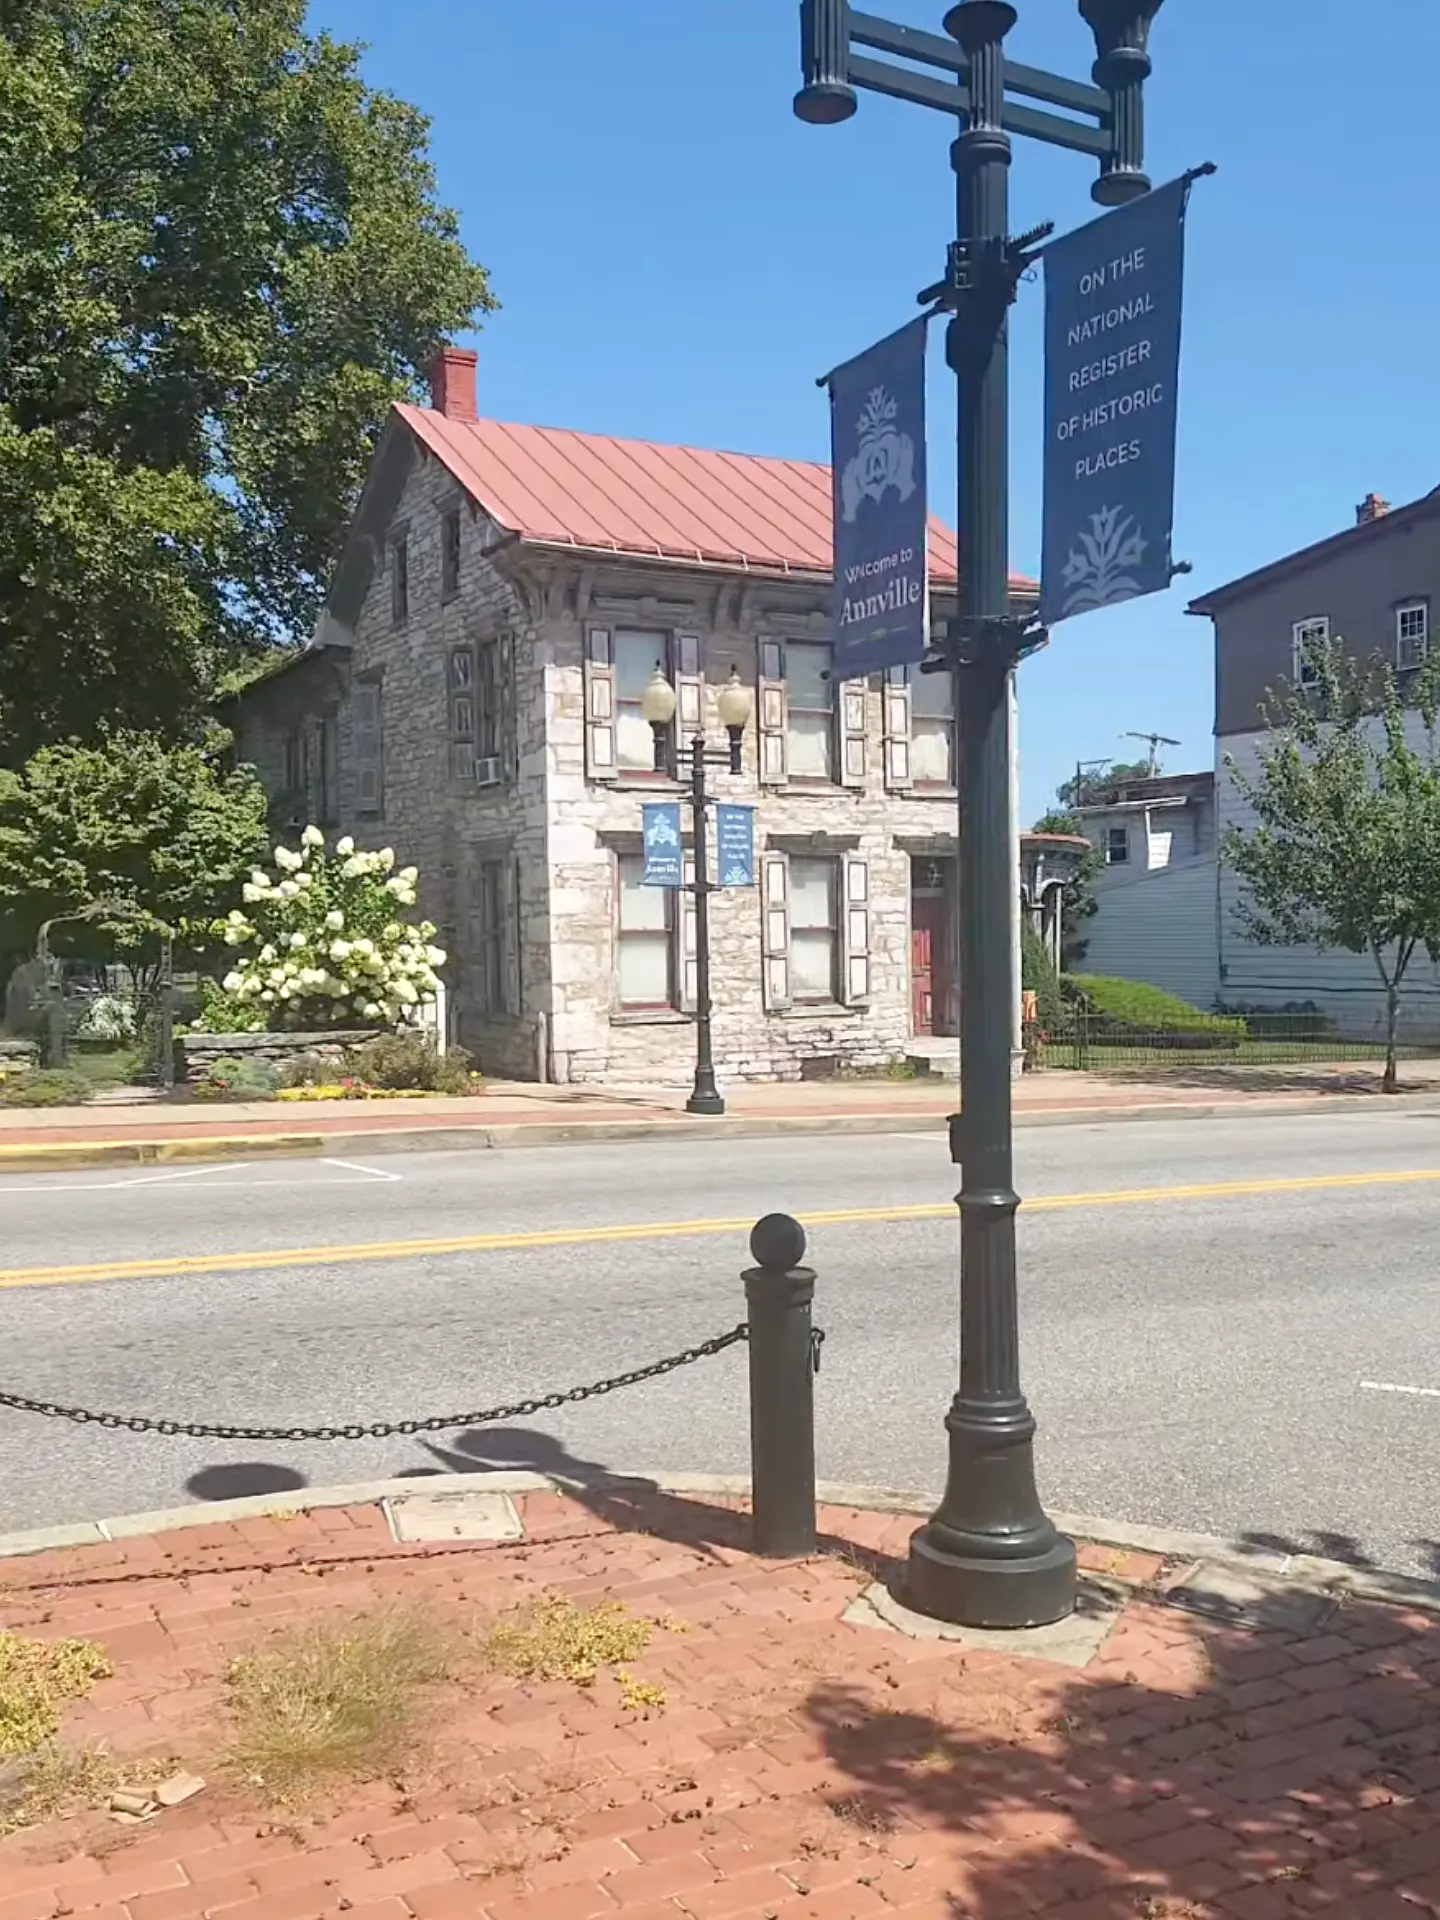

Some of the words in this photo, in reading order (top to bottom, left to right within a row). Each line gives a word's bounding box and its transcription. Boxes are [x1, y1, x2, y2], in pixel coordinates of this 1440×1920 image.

[1079, 267, 1106, 296] ON
[1109, 248, 1146, 282] THE
[1067, 292, 1155, 346] NATIONAL
[1069, 339, 1152, 392] REGISTER
[1057, 415, 1079, 441] OF
[1082, 383, 1163, 432] HISTORIC
[1075, 439, 1142, 480] PLACES
[900, 547, 913, 563] to
[839, 576, 921, 627] Annville
